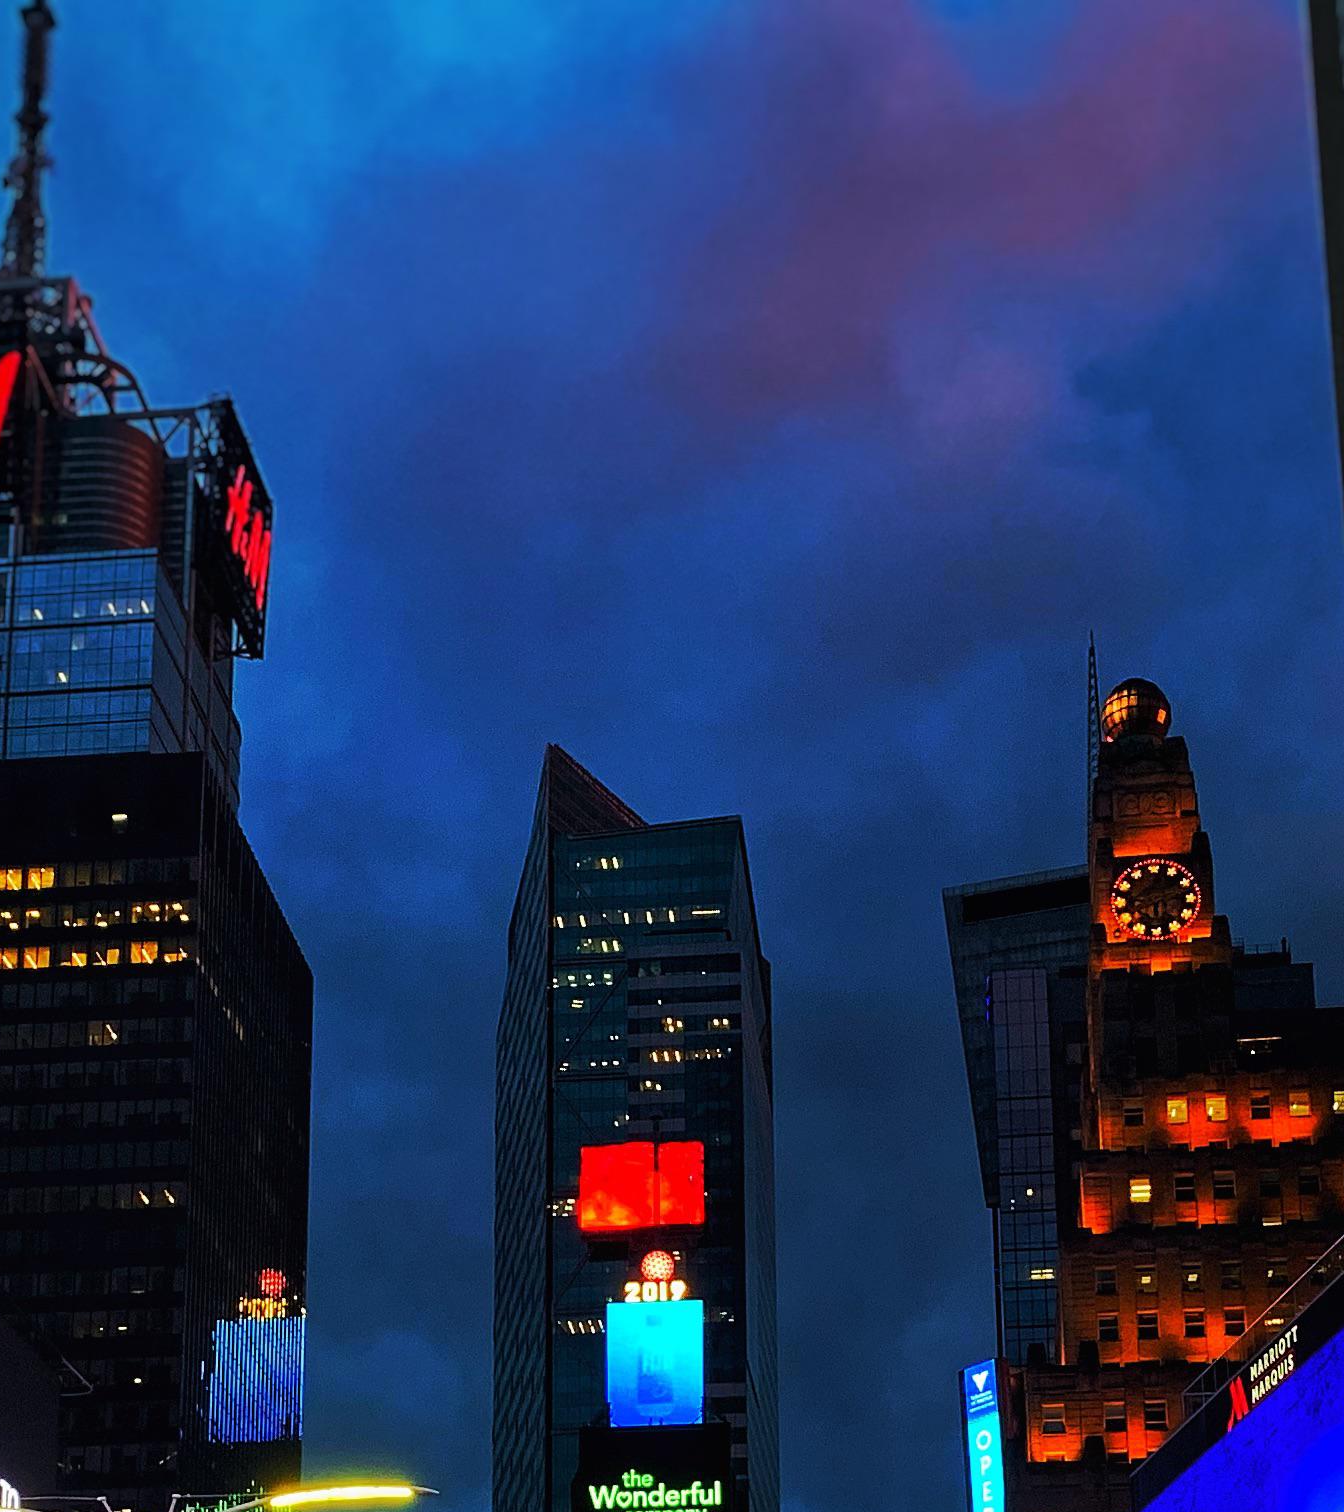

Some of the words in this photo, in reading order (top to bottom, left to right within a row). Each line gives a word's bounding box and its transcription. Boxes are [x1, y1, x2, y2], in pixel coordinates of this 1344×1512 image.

[624, 1281, 687, 1302] 2019
[1250, 1325, 1298, 1381] MARRIOTT
[1252, 1353, 1295, 1404] MARQUIS
[621, 1468, 654, 1488] the
[589, 1480, 722, 1510] Wonderful
